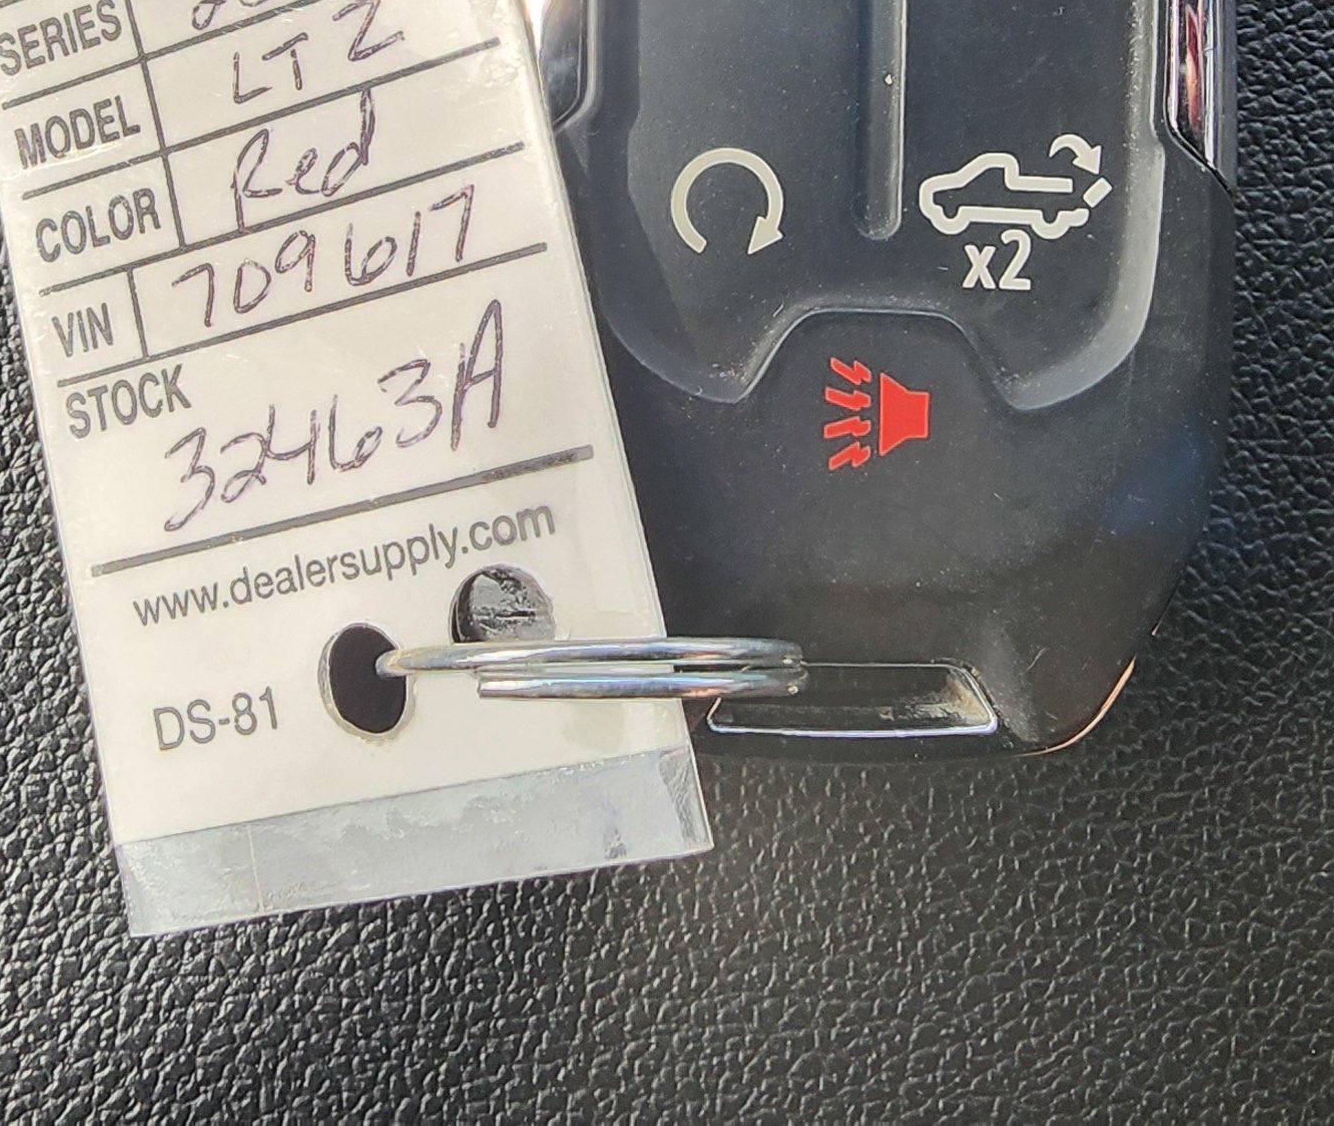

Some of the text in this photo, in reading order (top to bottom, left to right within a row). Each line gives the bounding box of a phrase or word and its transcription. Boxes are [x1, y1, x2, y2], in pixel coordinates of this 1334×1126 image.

[15, 95, 142, 169] MODEL
[230, 85, 376, 232] Red
[35, 187, 161, 263] COLOR
[171, 184, 476, 328] 709617
[53, 302, 114, 358] VIN
[65, 362, 192, 439] STOCK
[164, 299, 504, 532] 32463A
[132, 503, 556, 627] www.dealersupply.com
[153, 686, 279, 751] DS-81
